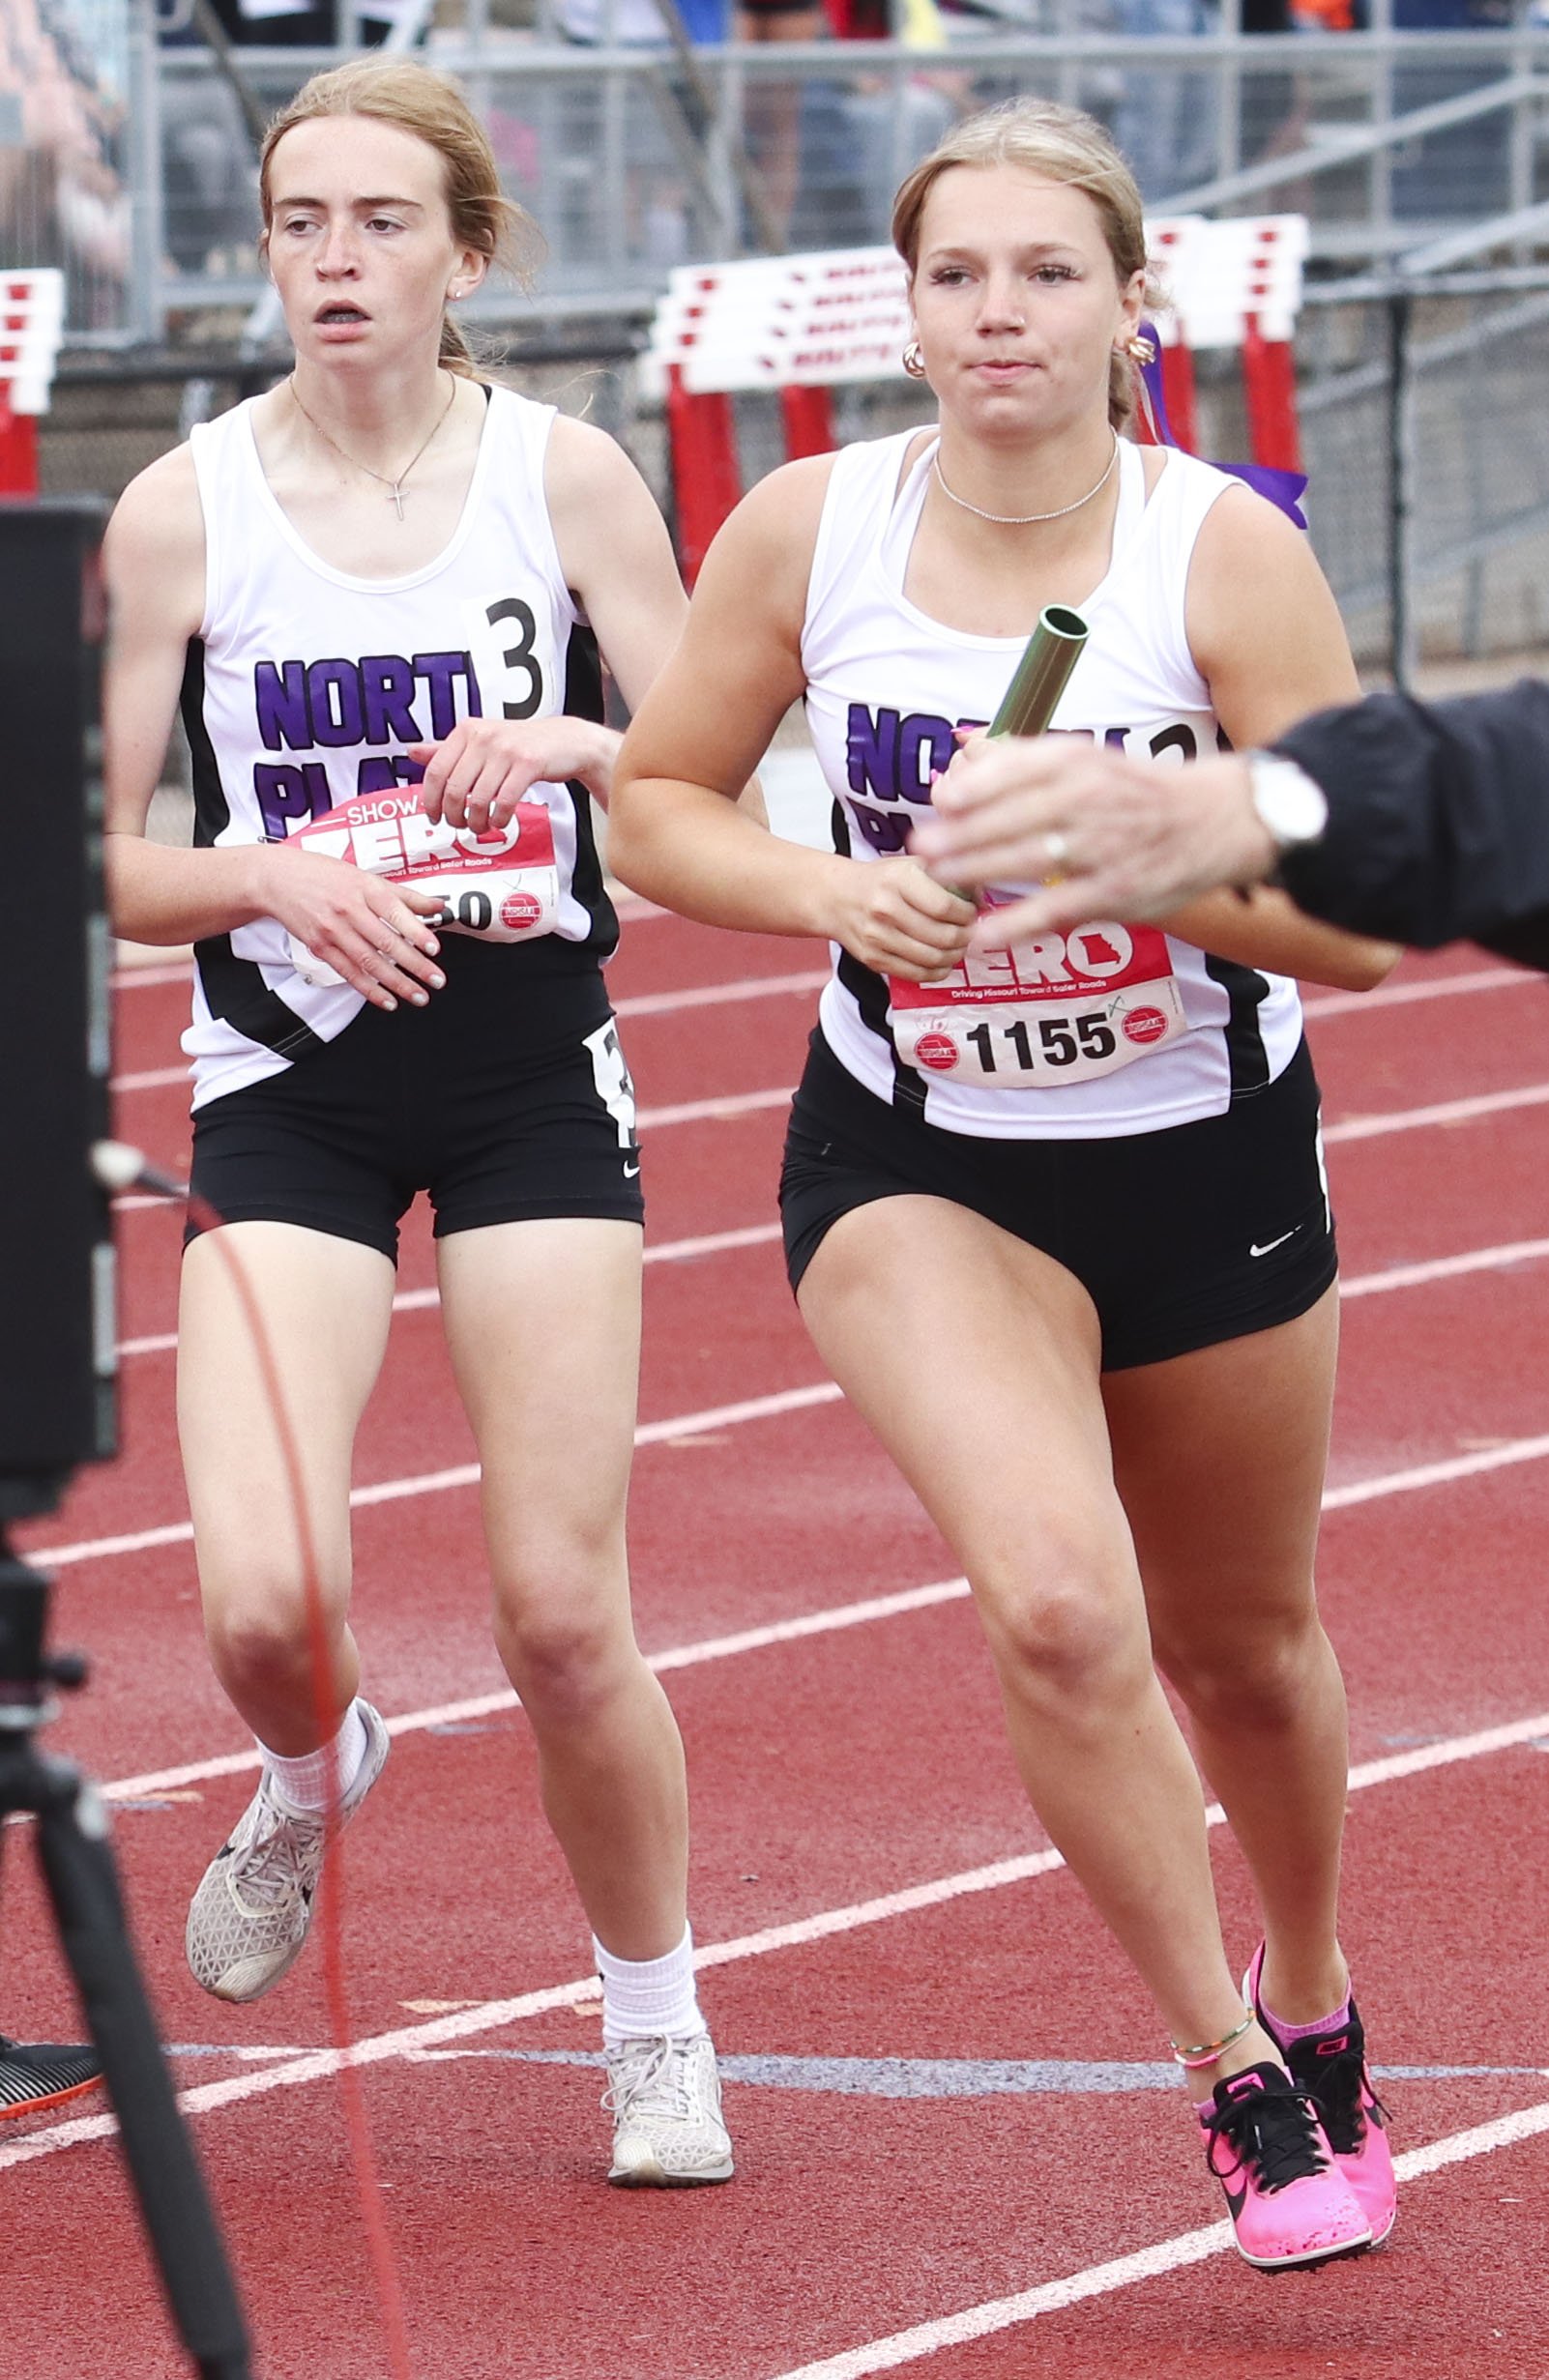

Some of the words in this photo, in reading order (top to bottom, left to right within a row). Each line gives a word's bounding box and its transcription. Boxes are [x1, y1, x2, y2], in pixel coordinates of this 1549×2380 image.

[485, 597, 542, 720] 3
[348, 793, 419, 827] SHOW
[408, 862, 440, 875] Toward
[464, 856, 493, 868] Roads
[920, 920, 1133, 989] ERO
[950, 989, 983, 1000] Driving
[983, 987, 1018, 998] Missouri
[1018, 985, 1052, 996] Toward
[1052, 983, 1077, 993] Safer
[1078, 979, 1107, 990] Roads
[967, 1012, 1116, 1073] 1155
